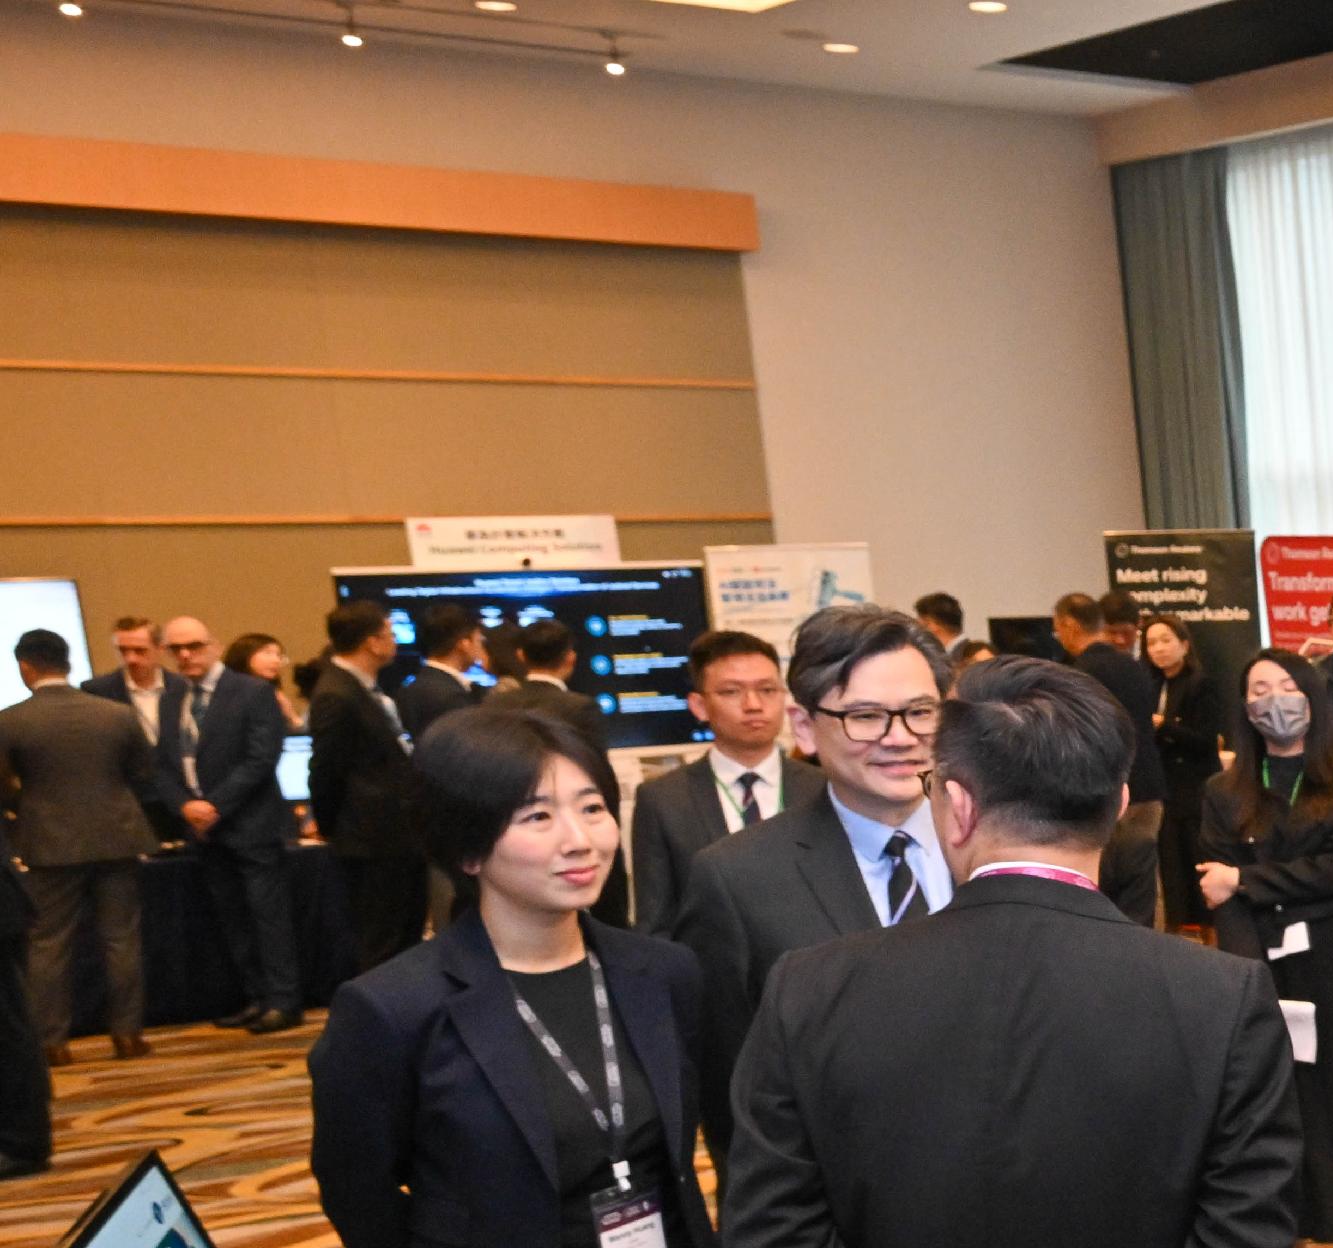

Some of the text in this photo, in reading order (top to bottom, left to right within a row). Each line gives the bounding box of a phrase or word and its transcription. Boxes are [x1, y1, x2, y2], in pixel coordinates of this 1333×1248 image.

[1116, 566, 1208, 585] Meet rising
[1272, 602, 1307, 621] work
